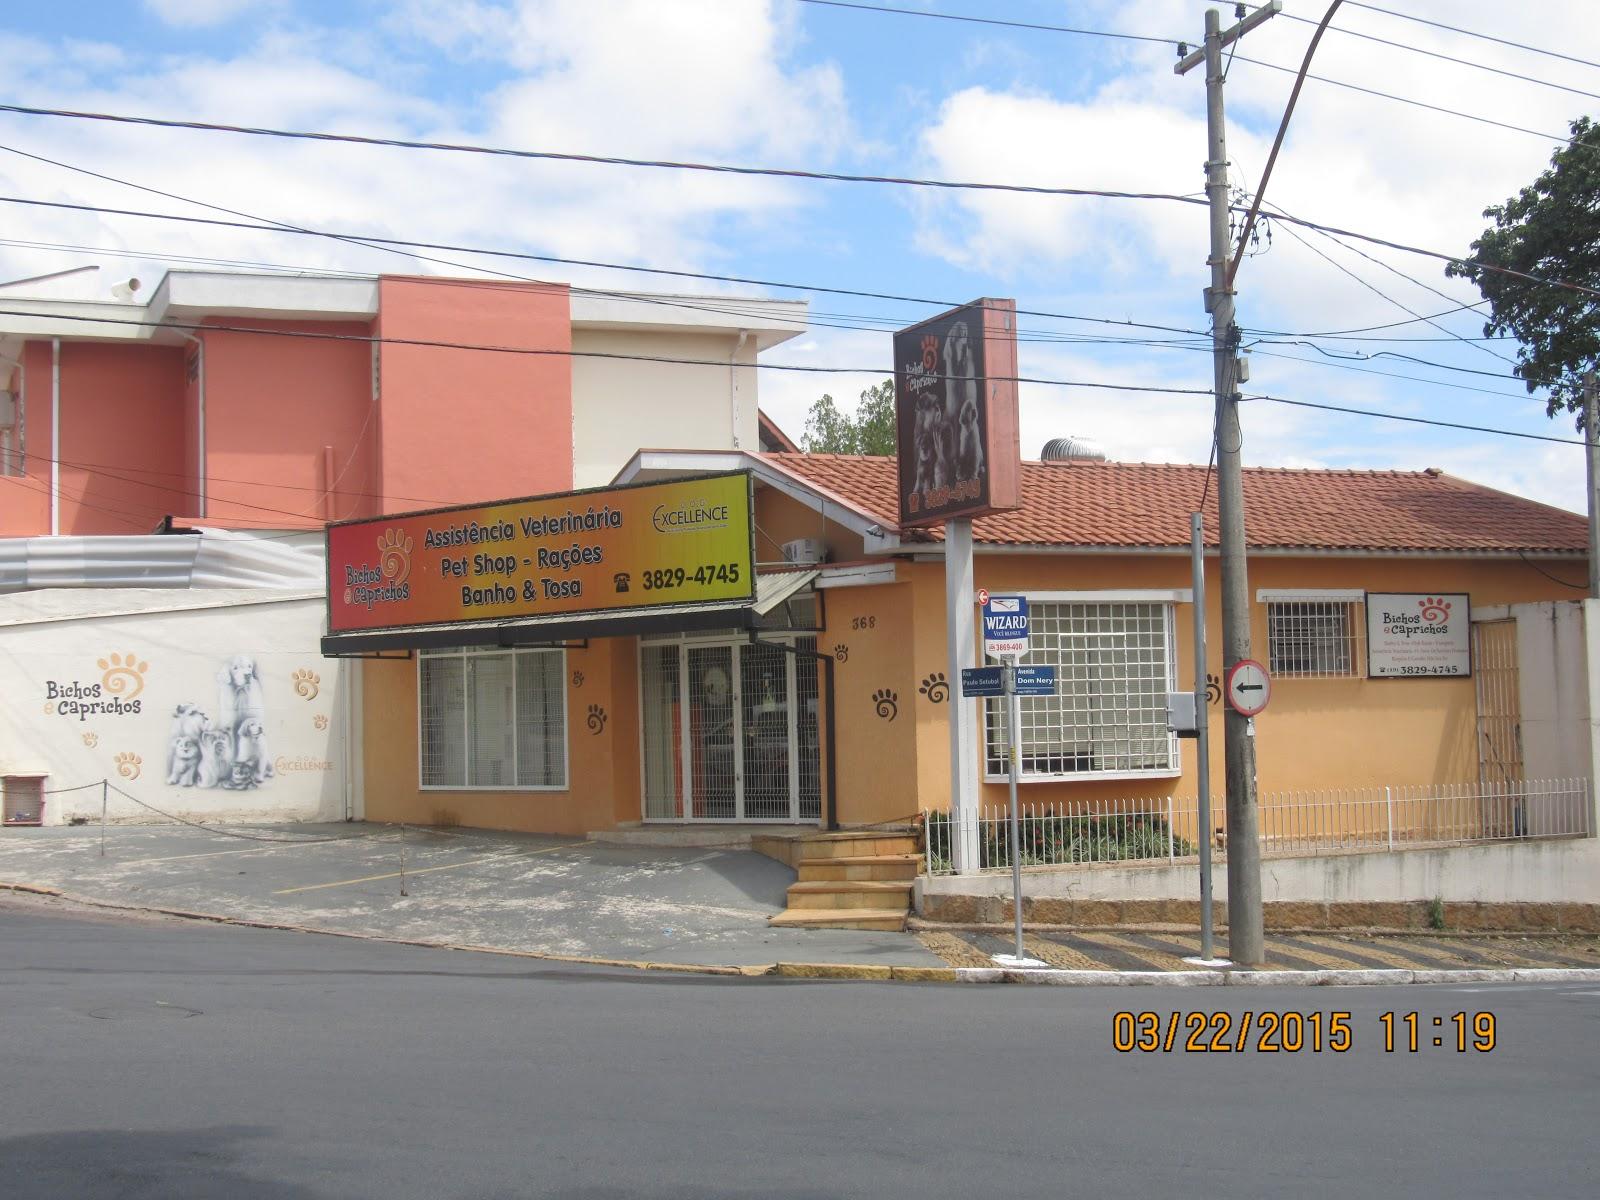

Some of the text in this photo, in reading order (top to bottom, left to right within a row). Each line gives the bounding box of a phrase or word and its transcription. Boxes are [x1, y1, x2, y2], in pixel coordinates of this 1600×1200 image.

[424, 506, 623, 549] Assistência Veterinária
[653, 504, 728, 533] EXCELLENCE
[441, 557, 469, 578] Pet
[473, 552, 517, 577] Shop
[537, 543, 603, 571] Rações
[345, 564, 382, 587] Bichos
[642, 563, 740, 590] 3829-4745
[353, 580, 410, 611] Caprichos
[461, 575, 582, 606] Banho & Tosa
[852, 616, 876, 630] 368
[985, 615, 1027, 630] WIZARD
[1383, 612, 1421, 625] Bichos
[1391, 623, 1449, 638] Caprichos
[1400, 665, 1458, 675] 3829-4745
[46, 680, 101, 700] Bichos
[43, 697, 142, 721] e Caprichos
